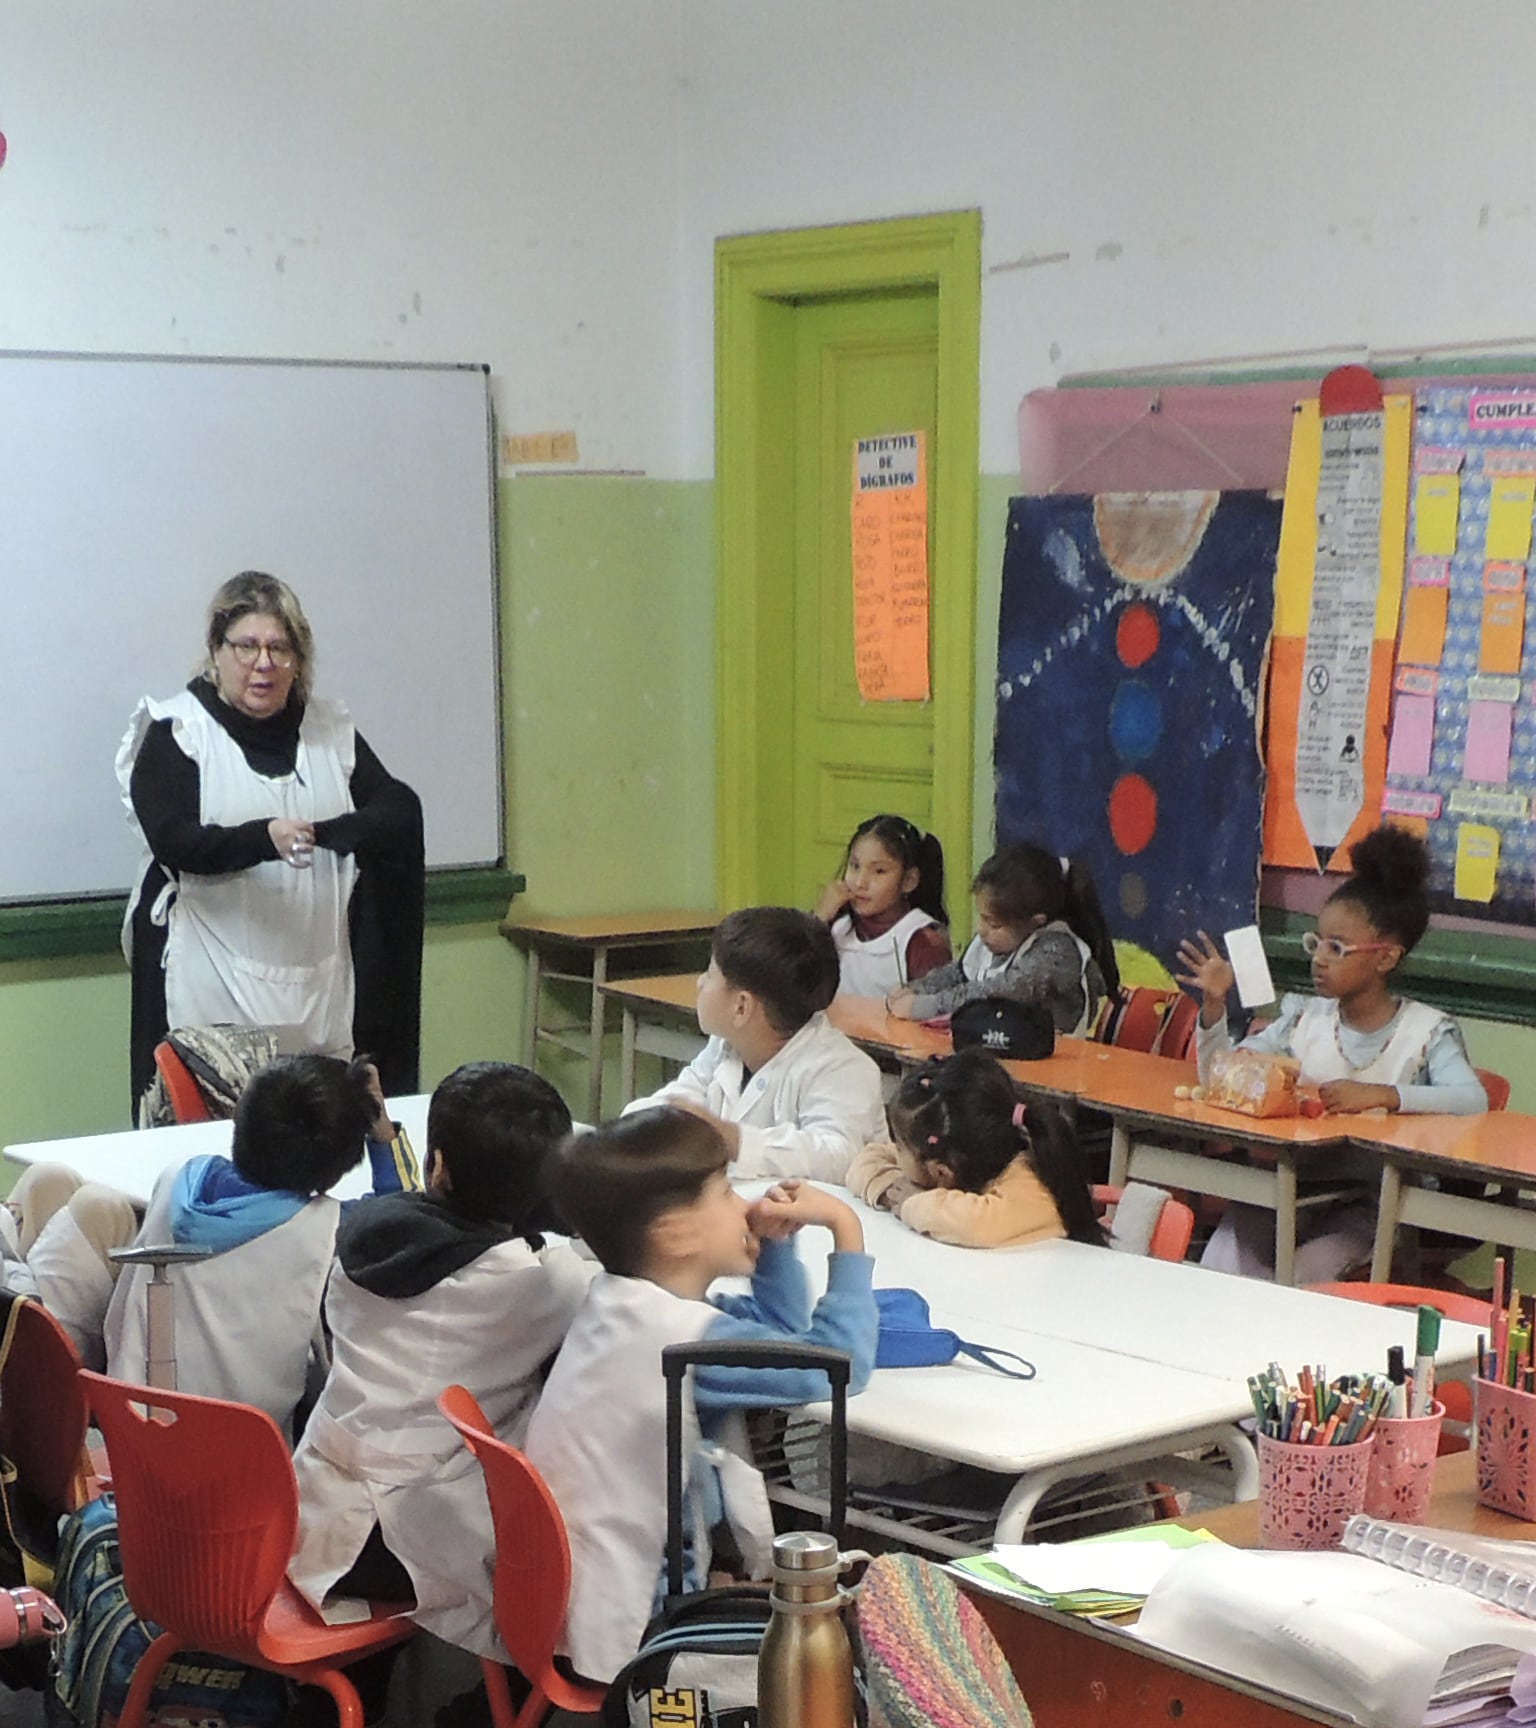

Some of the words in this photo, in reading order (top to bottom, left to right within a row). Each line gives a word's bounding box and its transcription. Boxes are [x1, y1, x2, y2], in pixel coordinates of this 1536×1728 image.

[858, 436, 916, 453] DETECTIVE
[879, 455, 893, 469] DE
[860, 472, 914, 490] DÍGRAFOS
[125, 1662, 246, 1690] OWER
